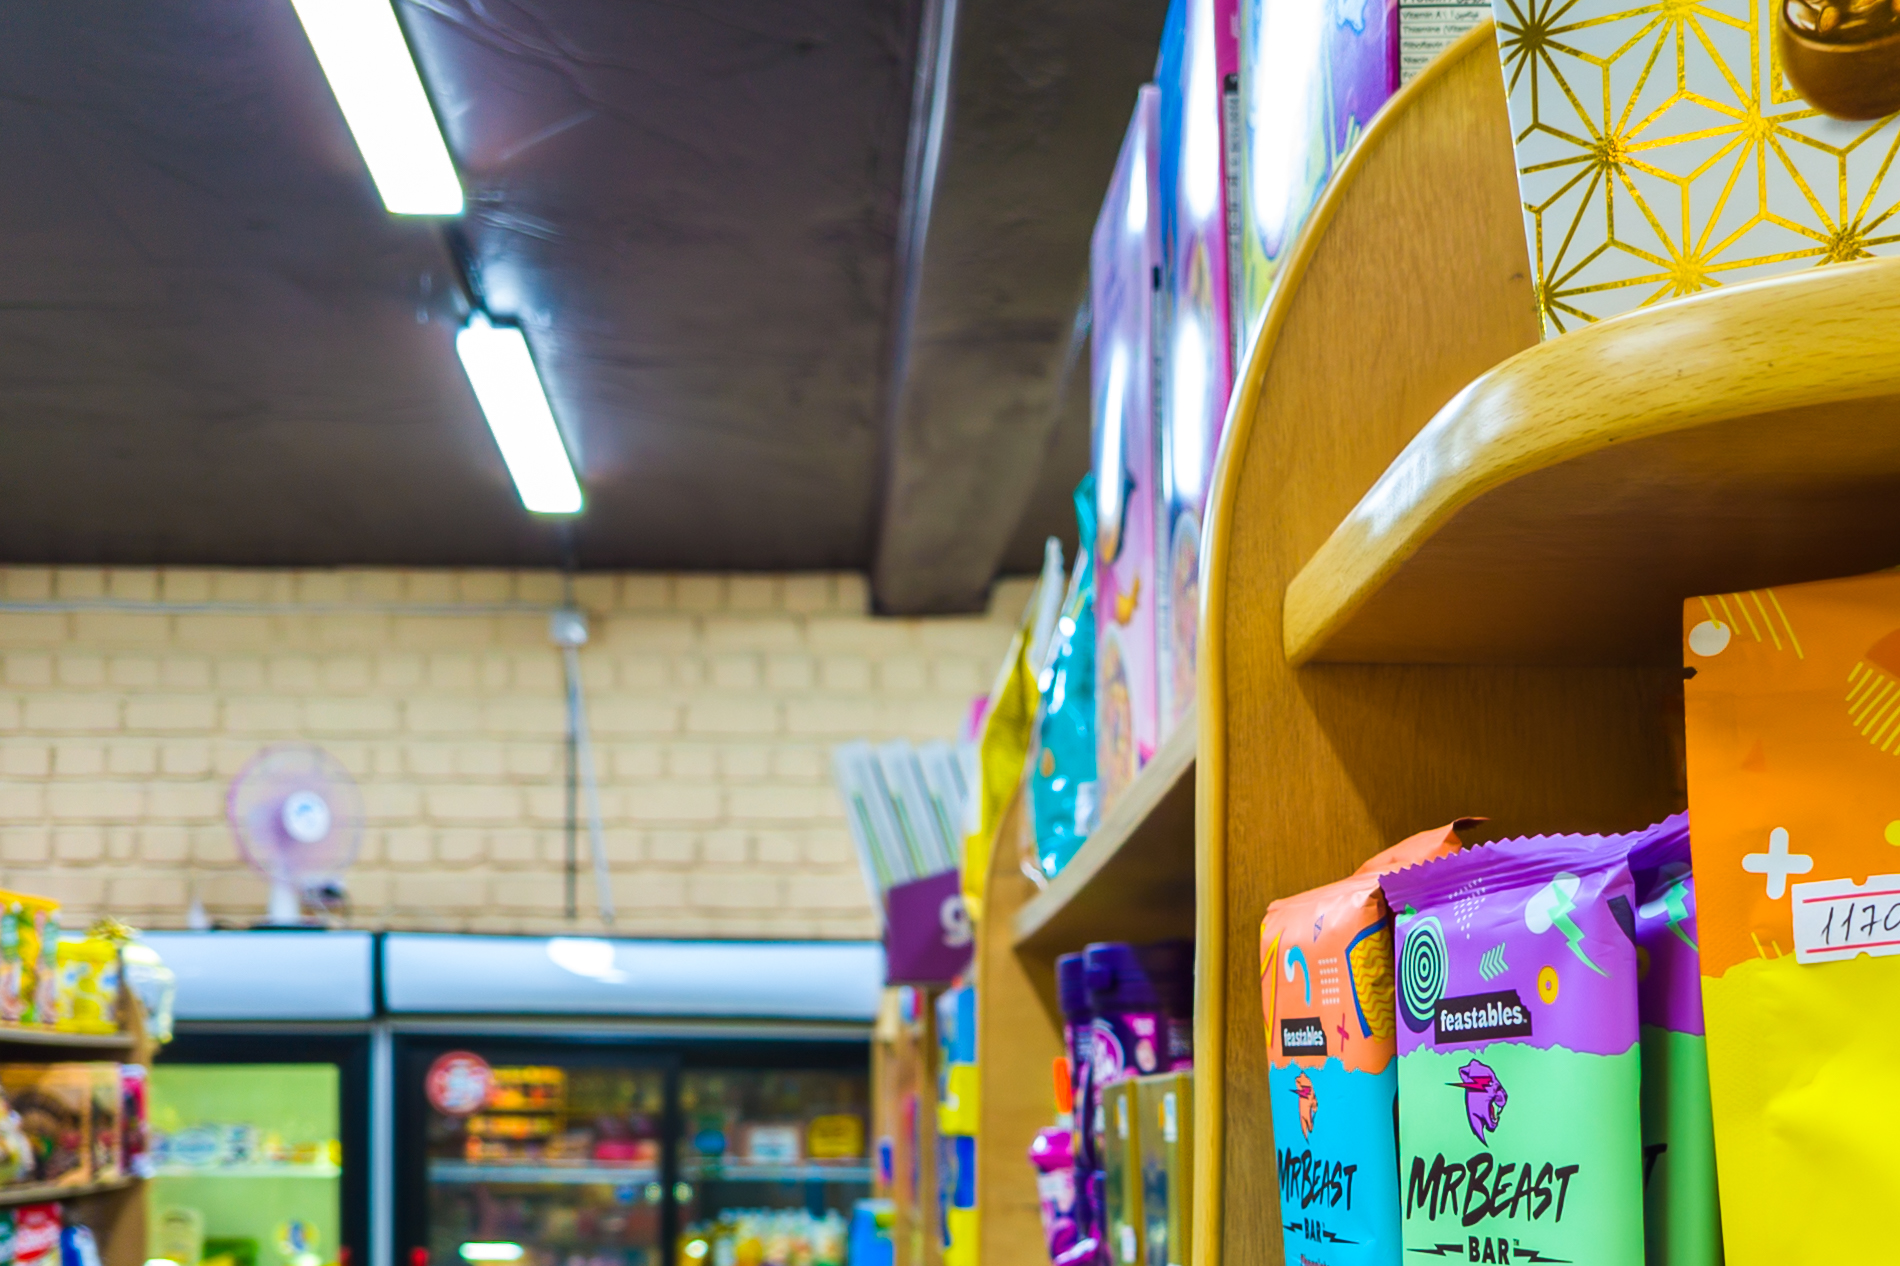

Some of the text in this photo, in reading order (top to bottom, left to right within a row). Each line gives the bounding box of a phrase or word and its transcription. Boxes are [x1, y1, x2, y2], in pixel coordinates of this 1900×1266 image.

[1439, 1003, 1524, 1032] feastables
[1283, 1026, 1325, 1049] feastables
[1304, 1217, 1323, 1244] BAR
[1467, 1235, 1511, 1266] BAR
